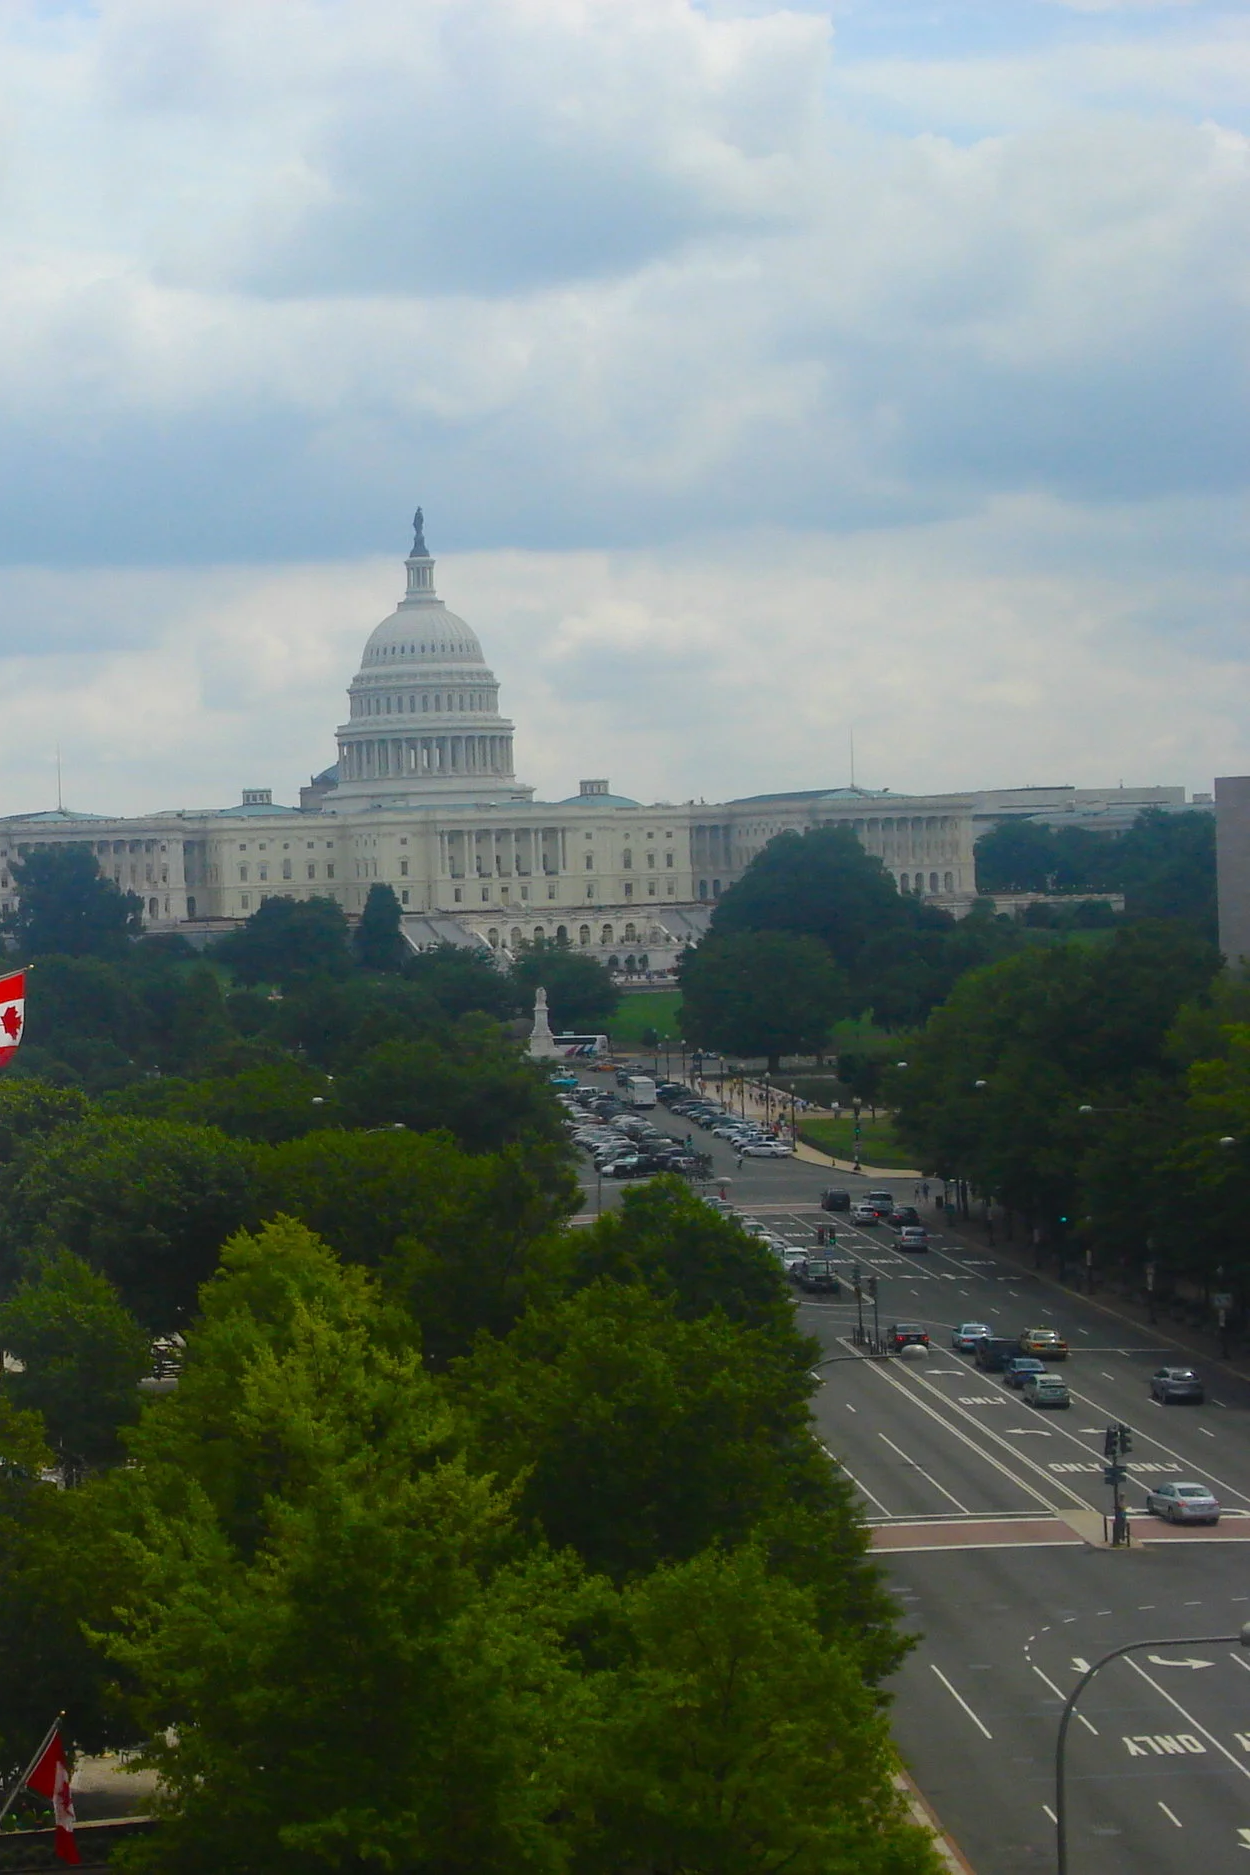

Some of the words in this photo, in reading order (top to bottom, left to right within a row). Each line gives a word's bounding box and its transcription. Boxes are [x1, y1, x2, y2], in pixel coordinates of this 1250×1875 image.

[958, 1396, 1007, 1405] ONLY
[1048, 1462, 1105, 1473] ONLY
[1125, 1462, 1183, 1472] ONLY
[1122, 1734, 1207, 1756] ONLY
